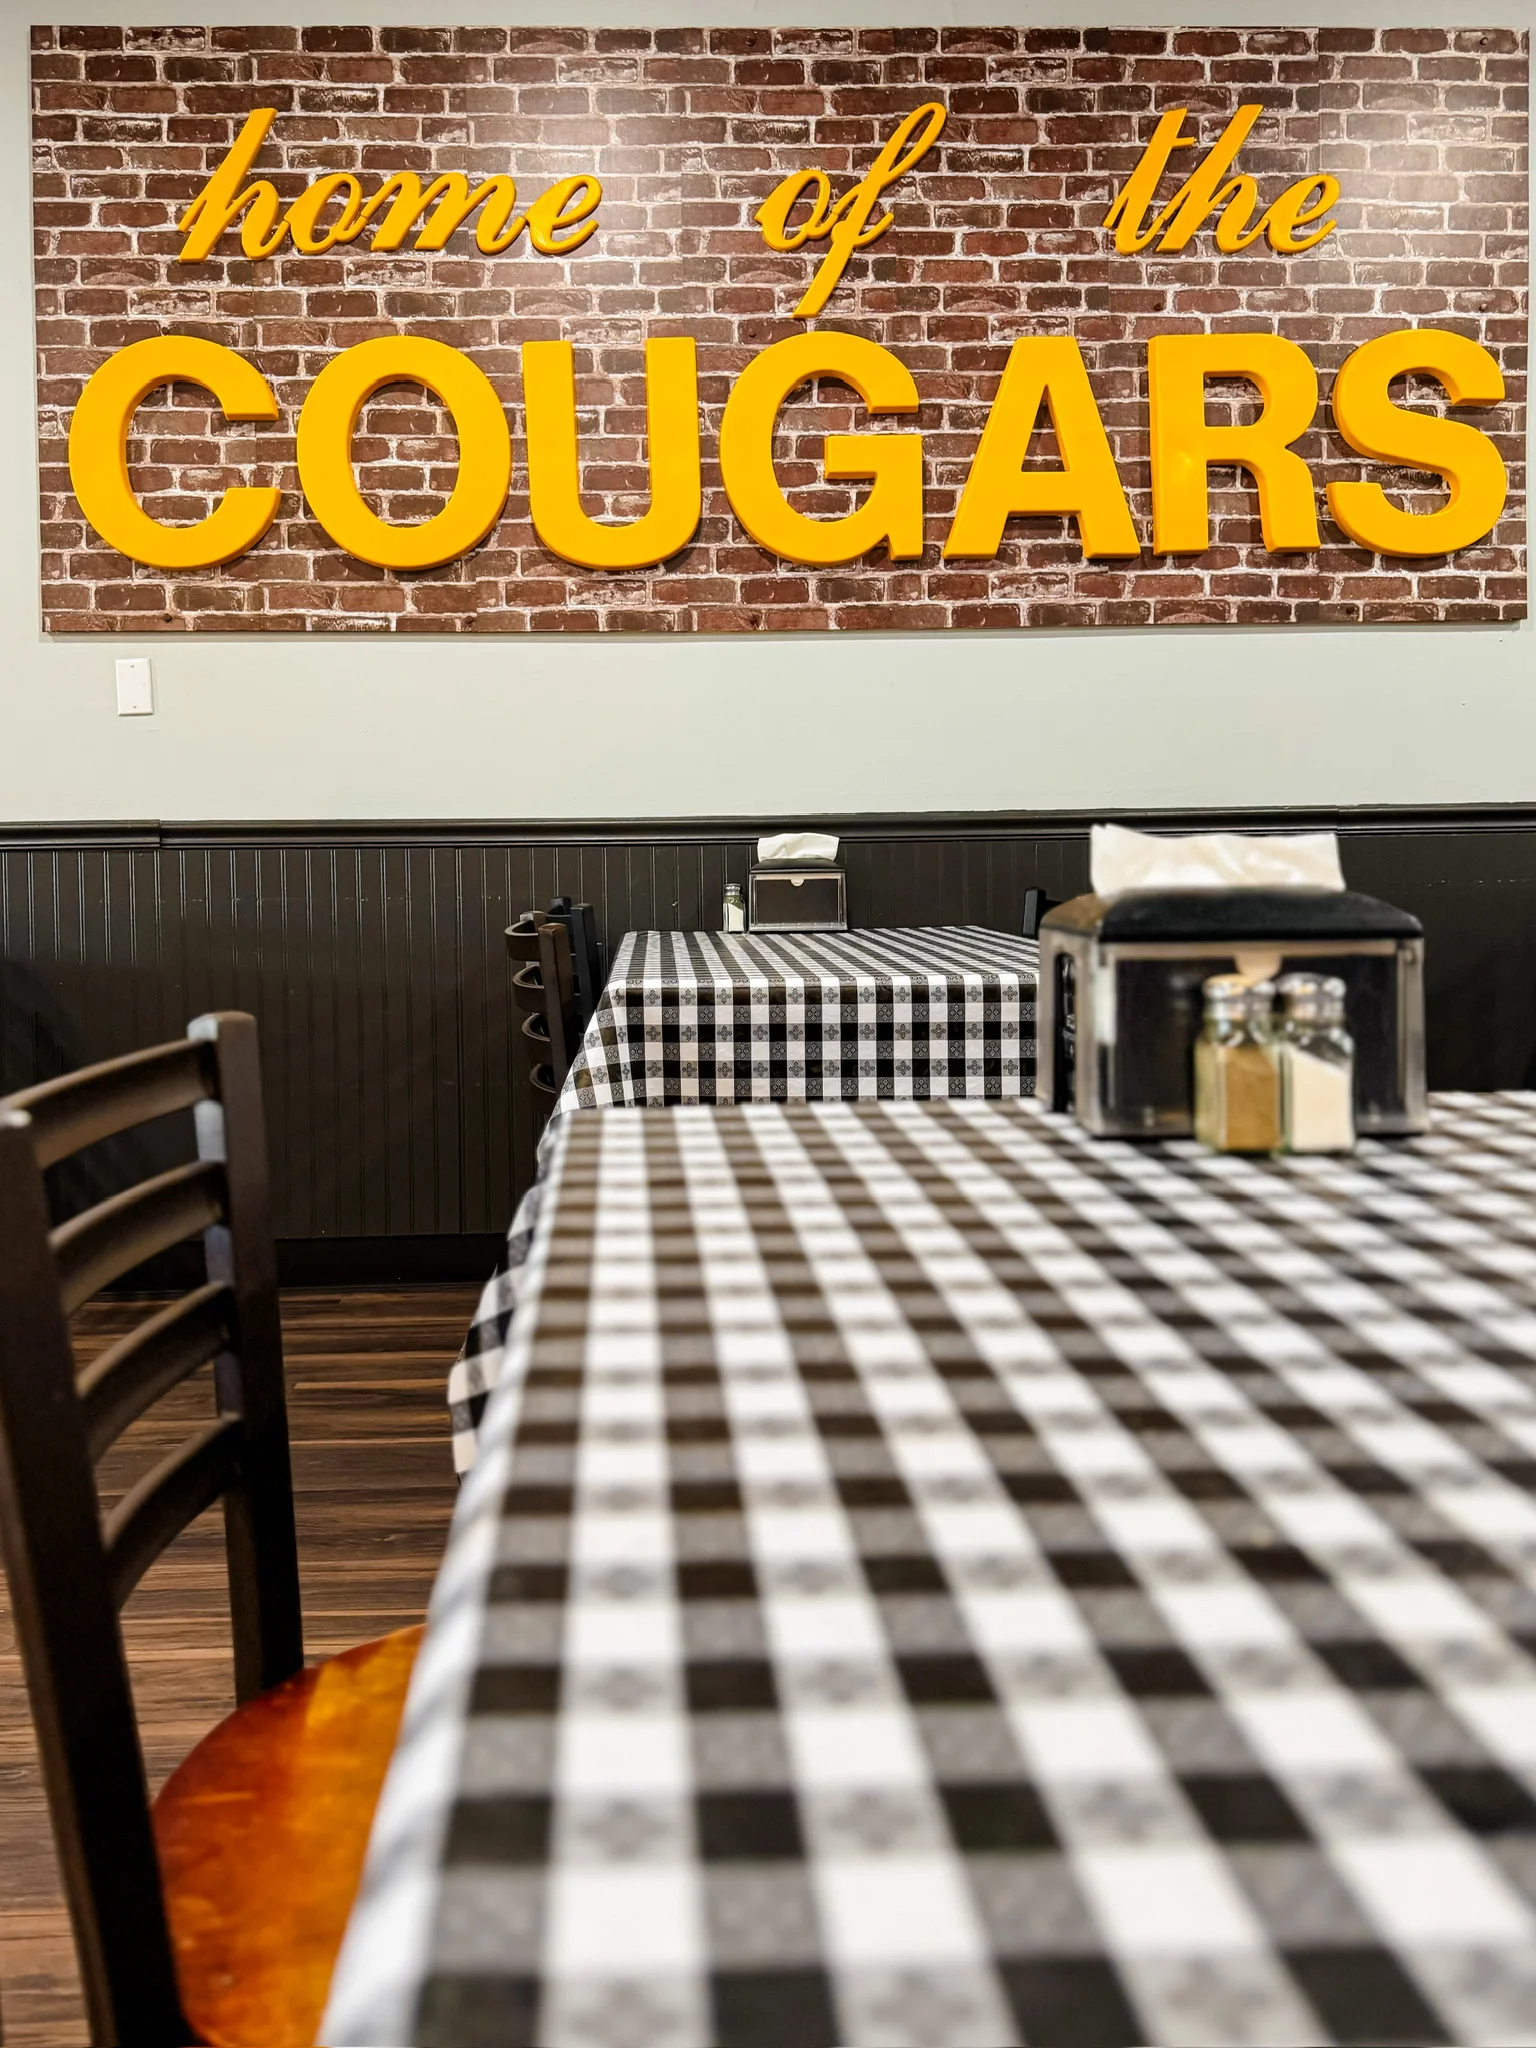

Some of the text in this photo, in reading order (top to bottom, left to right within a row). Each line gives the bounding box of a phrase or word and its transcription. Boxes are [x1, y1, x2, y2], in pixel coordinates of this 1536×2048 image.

[178, 101, 1340, 319] home of the
[67, 327, 1508, 570] COUGARS
